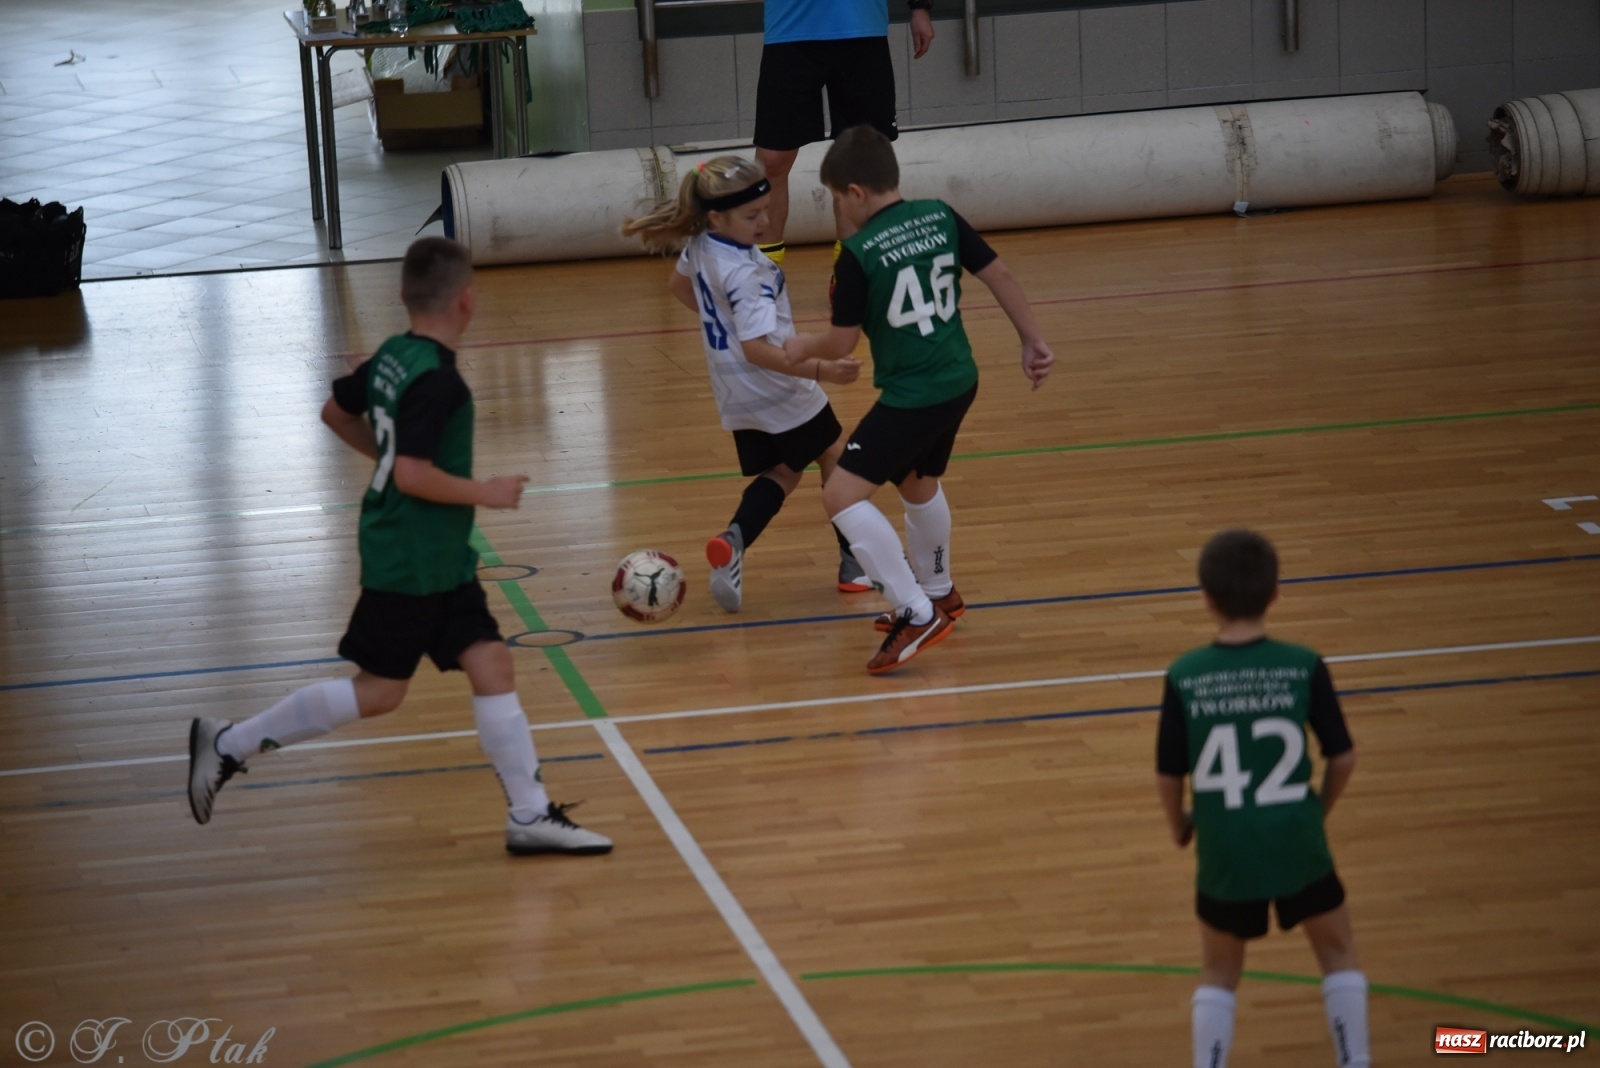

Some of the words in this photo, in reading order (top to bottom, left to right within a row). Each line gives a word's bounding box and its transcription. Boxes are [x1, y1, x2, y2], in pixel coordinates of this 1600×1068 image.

[880, 232, 948, 267] TWORKÓW
[887, 252, 956, 337] 46
[1191, 716, 1309, 810] 42
